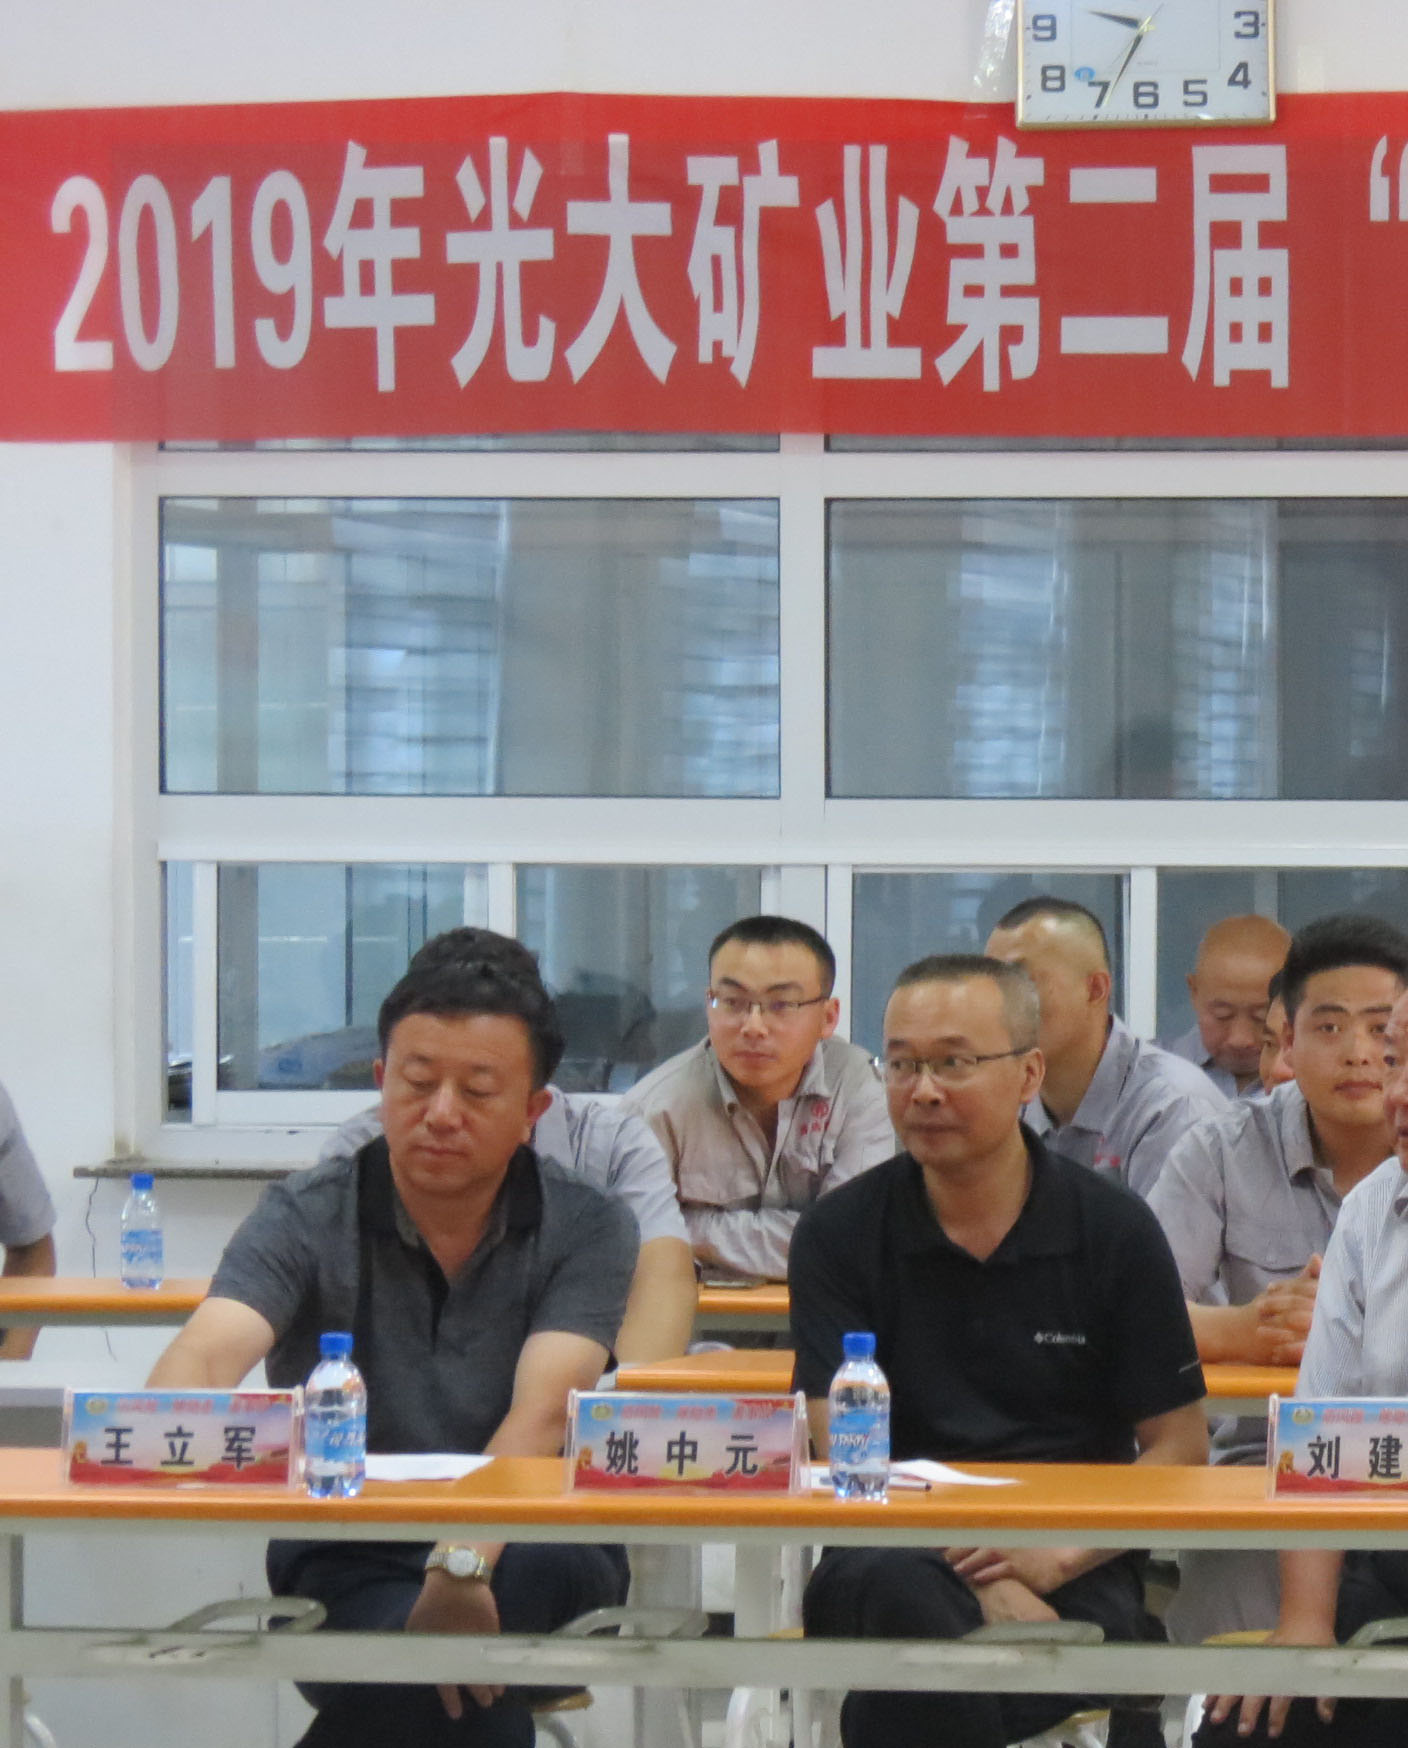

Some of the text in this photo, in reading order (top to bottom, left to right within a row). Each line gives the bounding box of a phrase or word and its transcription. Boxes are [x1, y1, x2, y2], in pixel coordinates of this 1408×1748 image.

[1032, 14, 1057, 42] 9
[1234, 10, 1260, 39] 3
[1041, 65, 1066, 92] 8
[1227, 61, 1251, 90] 4
[1088, 81, 1111, 108] 7
[1133, 81, 1159, 109] 6
[1183, 79, 1208, 107] 5
[101, 1424, 256, 1470] 王立军
[606, 1430, 758, 1476] 姚中元
